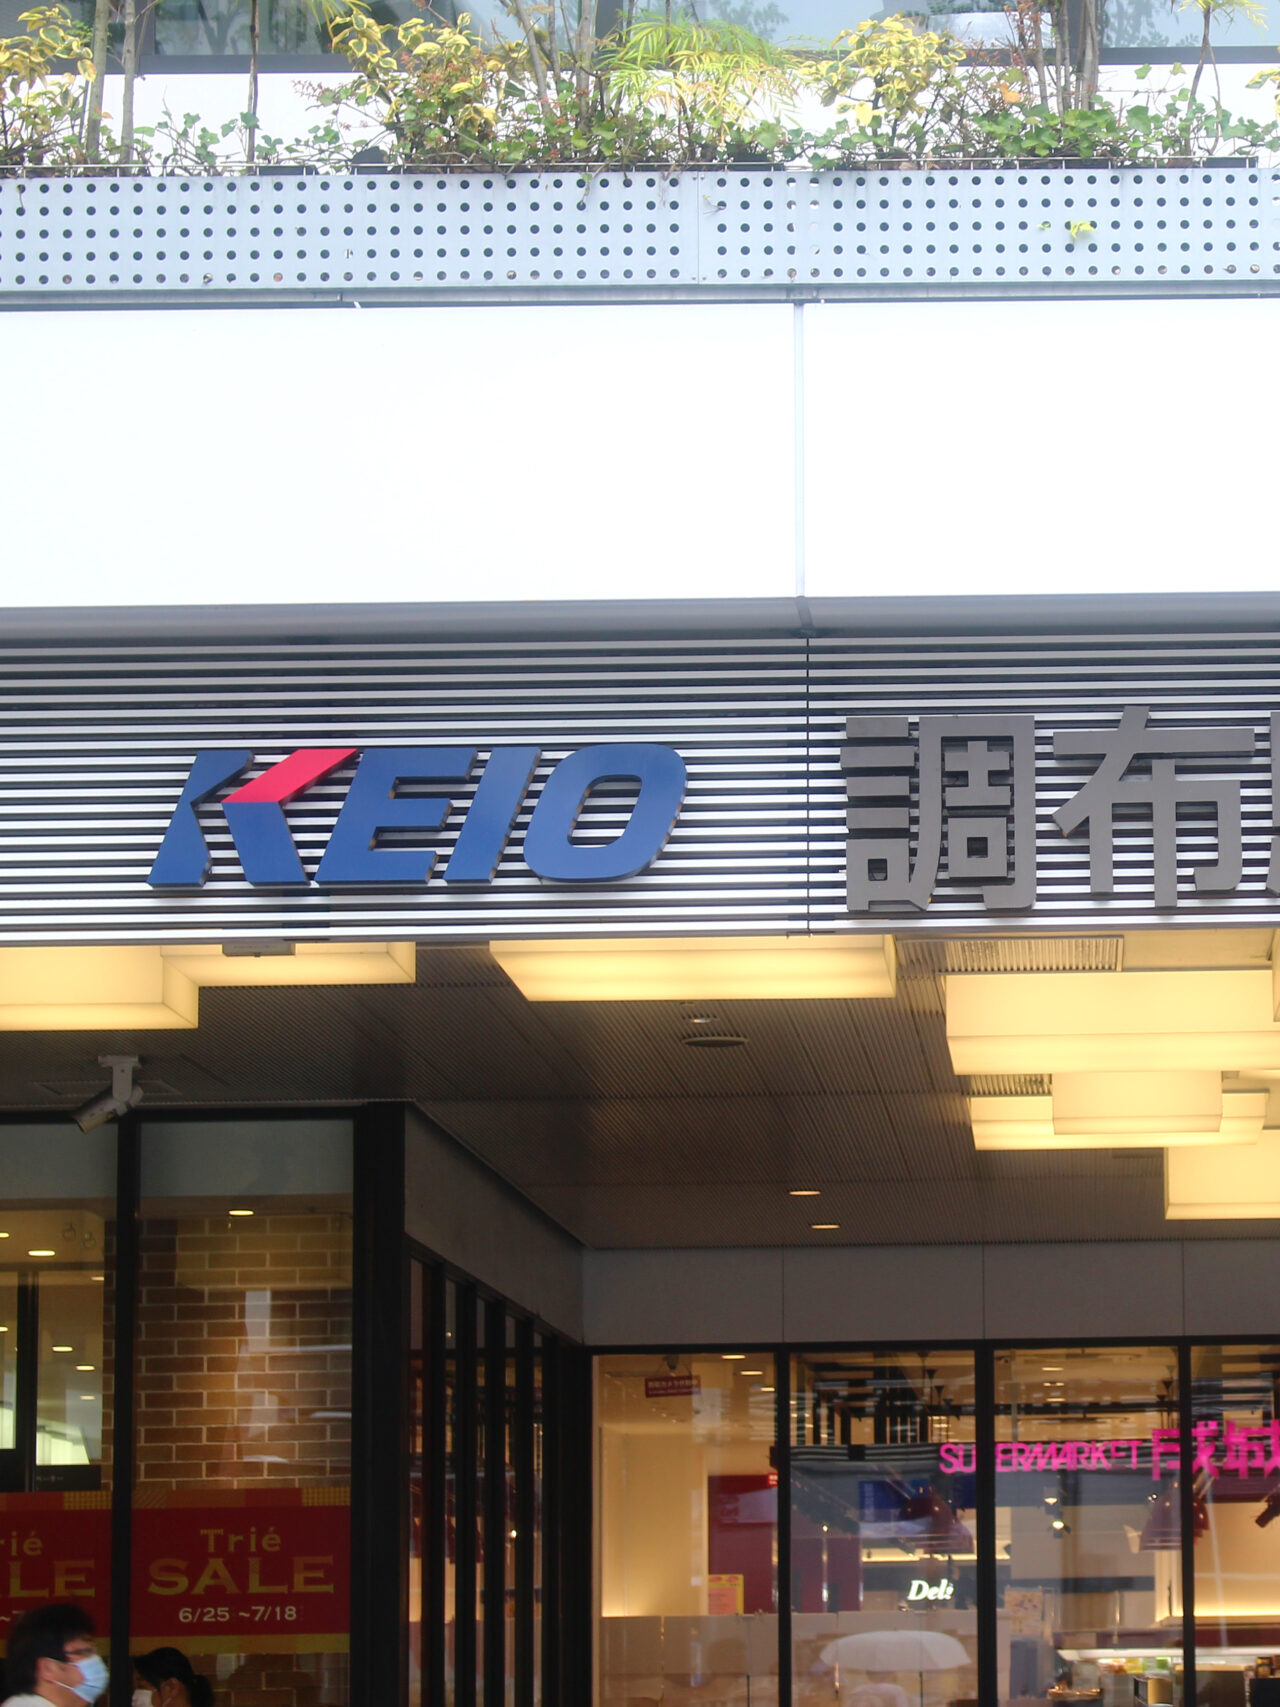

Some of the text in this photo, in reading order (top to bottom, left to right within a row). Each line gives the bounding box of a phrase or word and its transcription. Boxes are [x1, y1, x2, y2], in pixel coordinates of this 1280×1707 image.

[147, 743, 686, 888] KEIO
[939, 1441, 1143, 1474] SUERMARKET
[200, 1527, 281, 1552] Trié
[148, 1556, 334, 1595] SALE
[178, 1607, 230, 1623] 6/25
